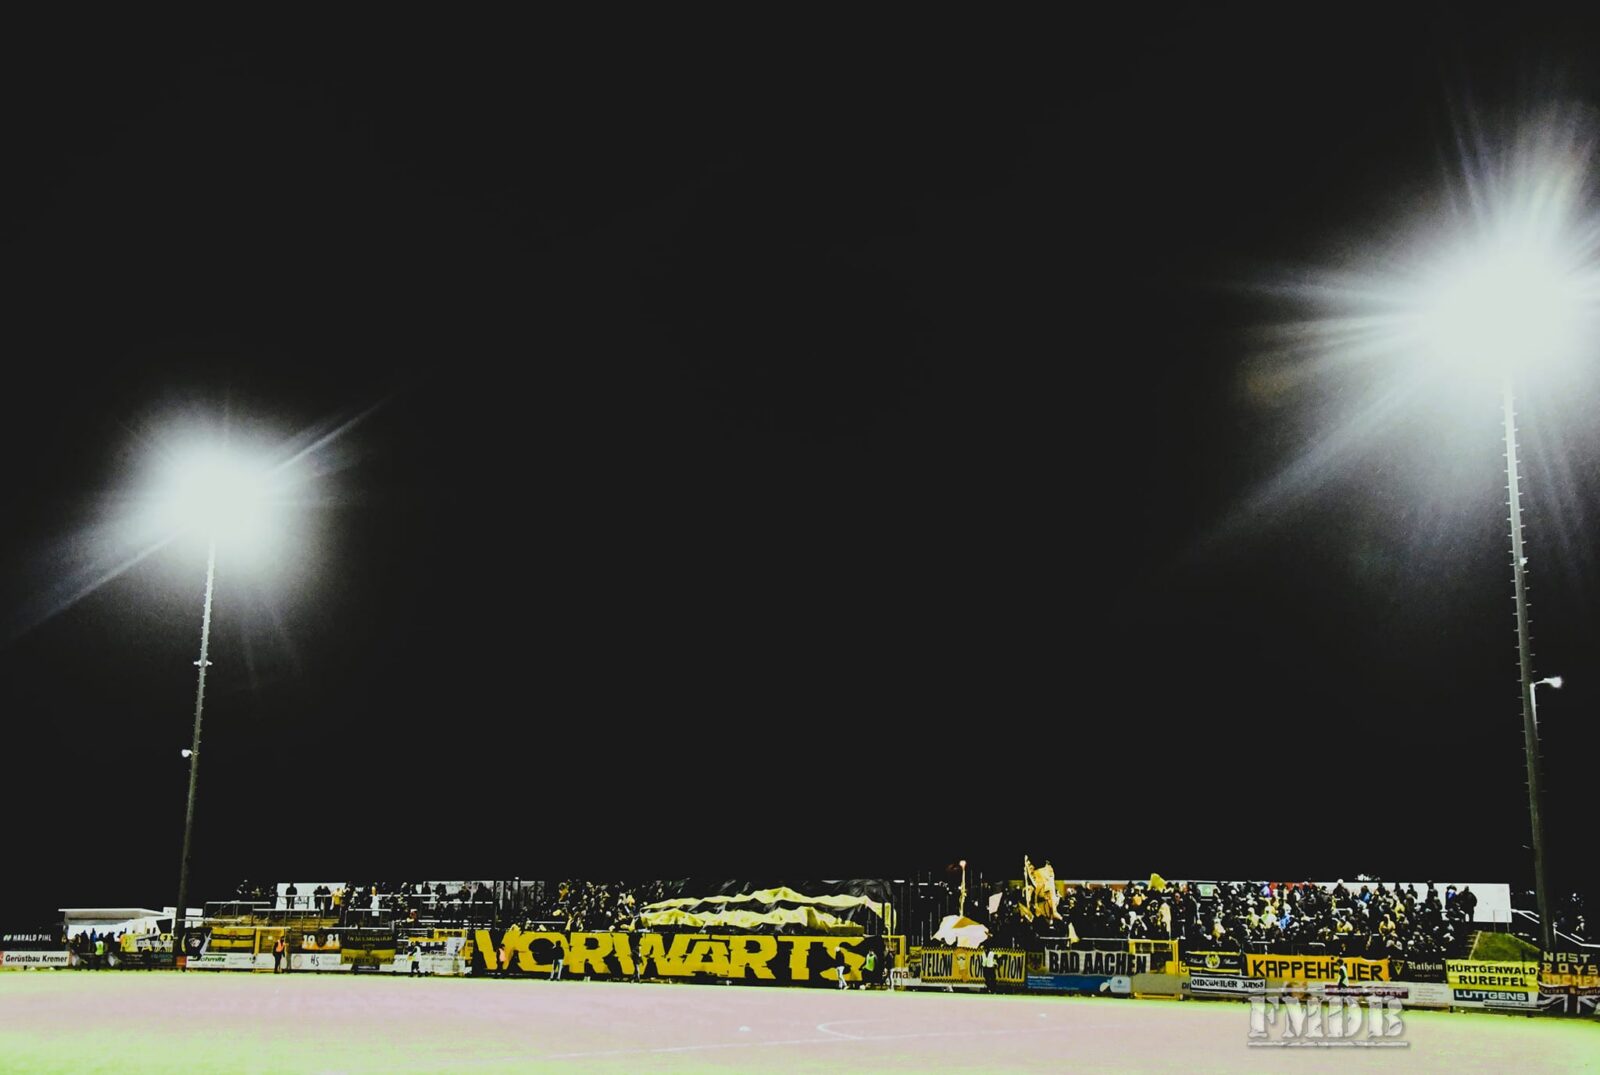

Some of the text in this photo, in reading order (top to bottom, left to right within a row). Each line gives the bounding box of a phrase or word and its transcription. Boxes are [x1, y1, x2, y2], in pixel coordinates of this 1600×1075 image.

[13, 934, 52, 942] HARALD PIHL
[5, 954, 68, 963] Gerüstbau Kremer
[922, 952, 953, 977] YELLOW
[1049, 951, 1147, 976] BAD AACHEN
[1541, 962, 1599, 975] BOYS
[1458, 975, 1528, 987] RUREIFEL
